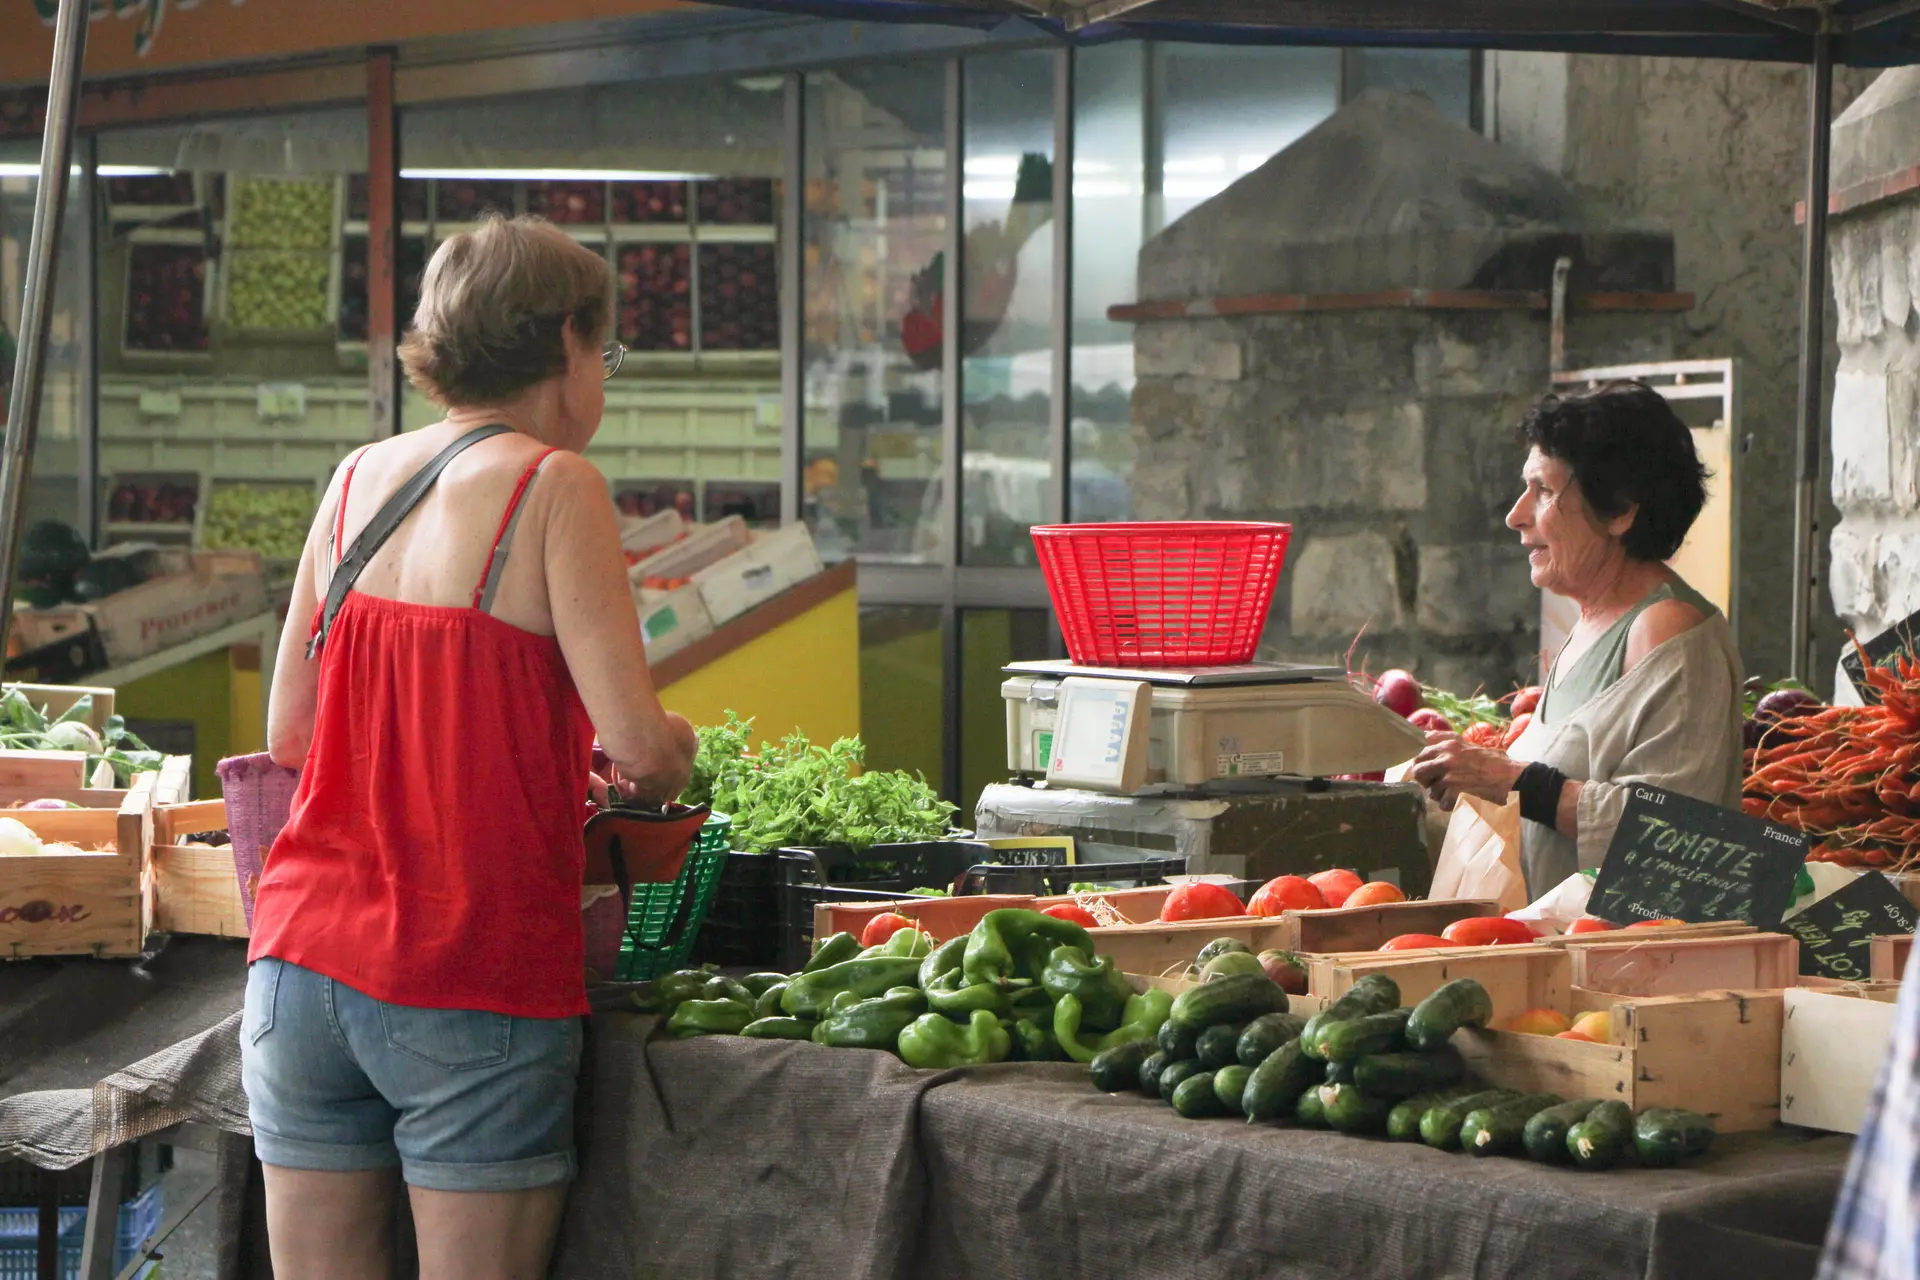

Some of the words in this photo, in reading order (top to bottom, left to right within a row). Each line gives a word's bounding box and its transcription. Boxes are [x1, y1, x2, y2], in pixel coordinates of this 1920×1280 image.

[1635, 787, 1653, 802] Cat
[1637, 813, 1764, 878] TOMATE
[1763, 826, 1803, 847] France
